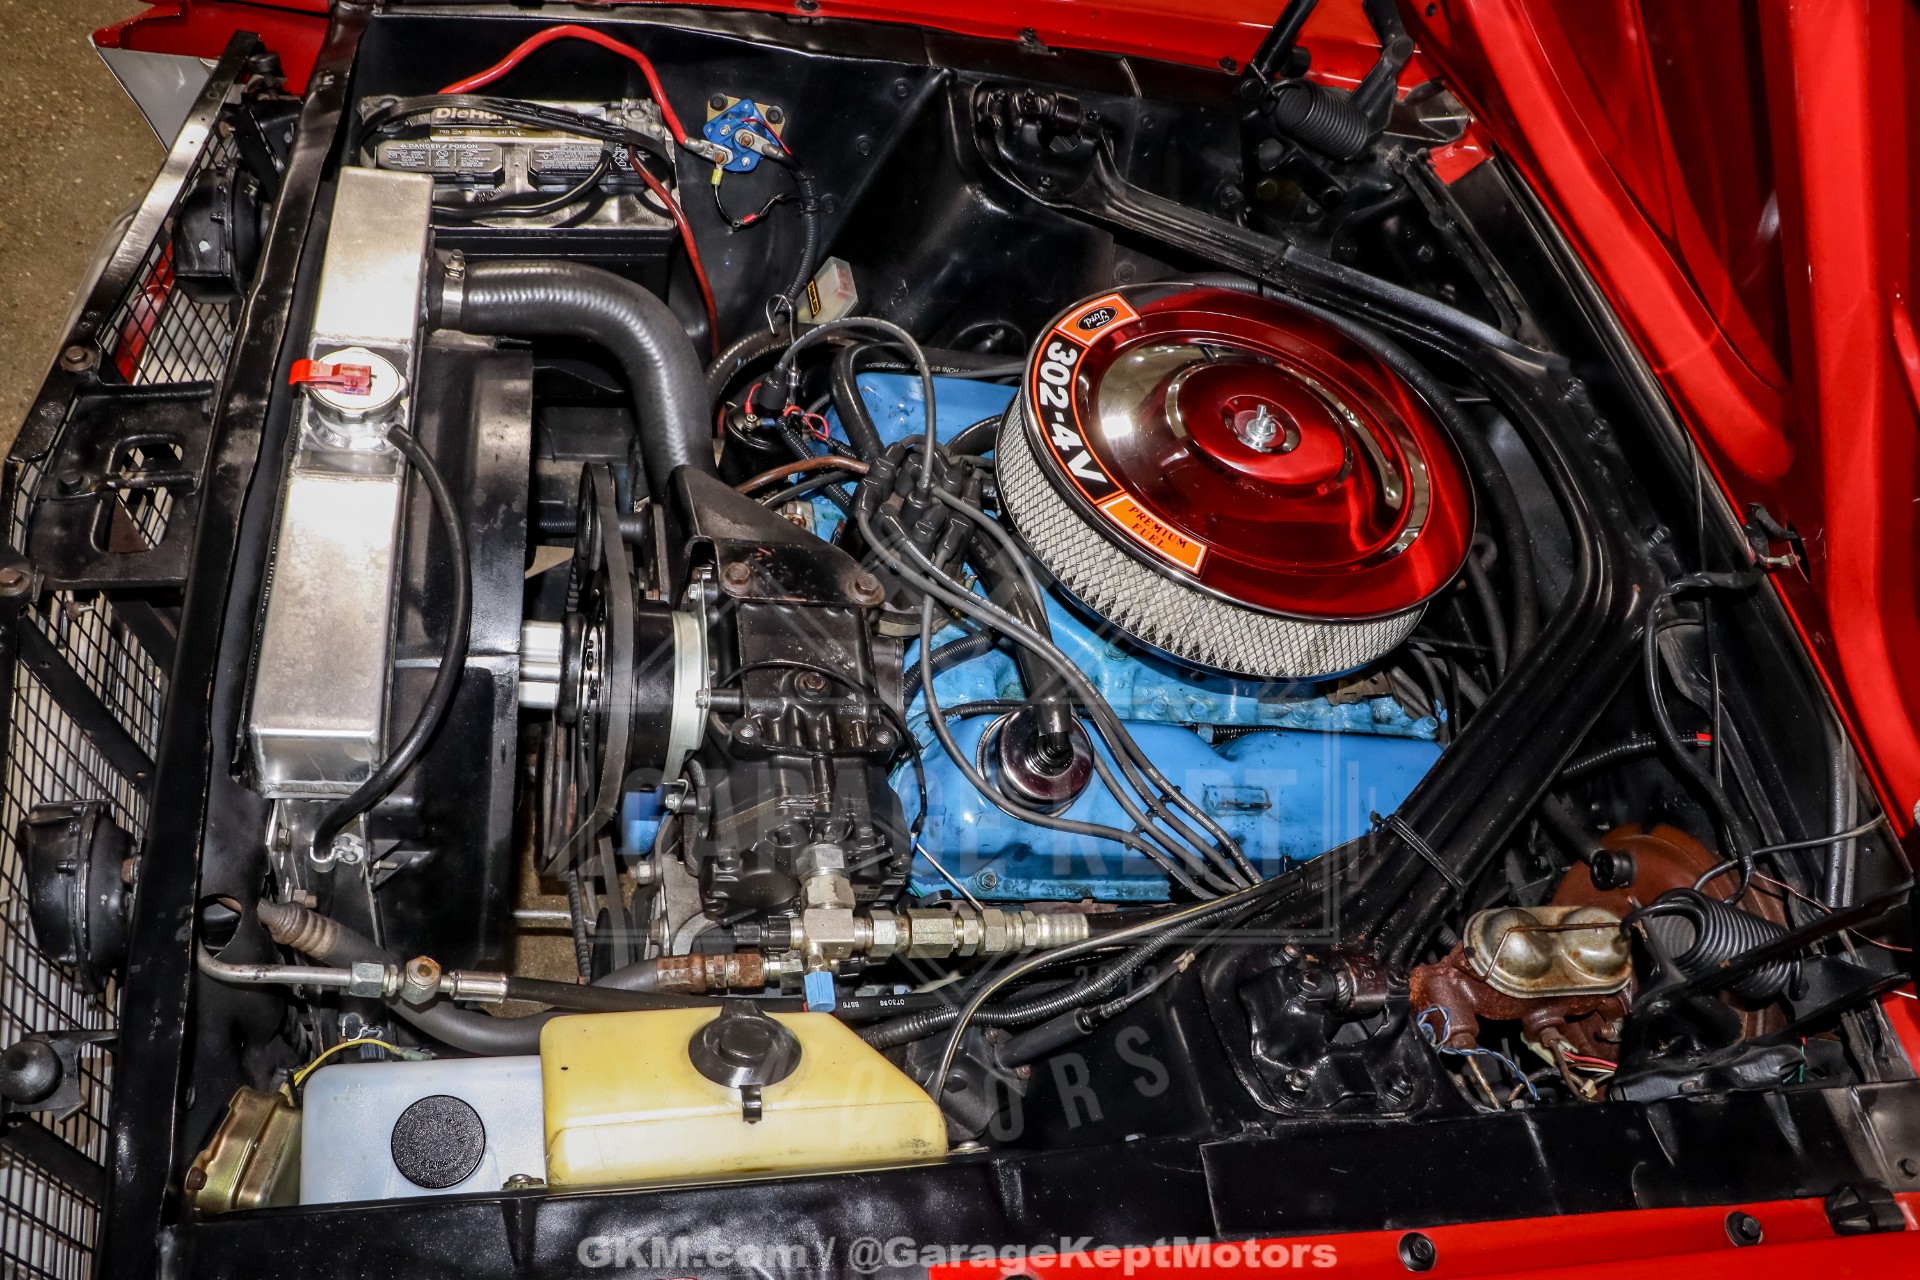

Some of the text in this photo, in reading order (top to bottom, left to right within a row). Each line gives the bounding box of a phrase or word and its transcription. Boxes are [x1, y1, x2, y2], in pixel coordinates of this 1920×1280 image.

[436, 107, 503, 120] DieHa
[1083, 310, 1110, 329] Ford
[1039, 342, 1108, 484] 302-4V
[1128, 505, 1187, 549] PREMIUM
[1132, 522, 1164, 549] FUEL
